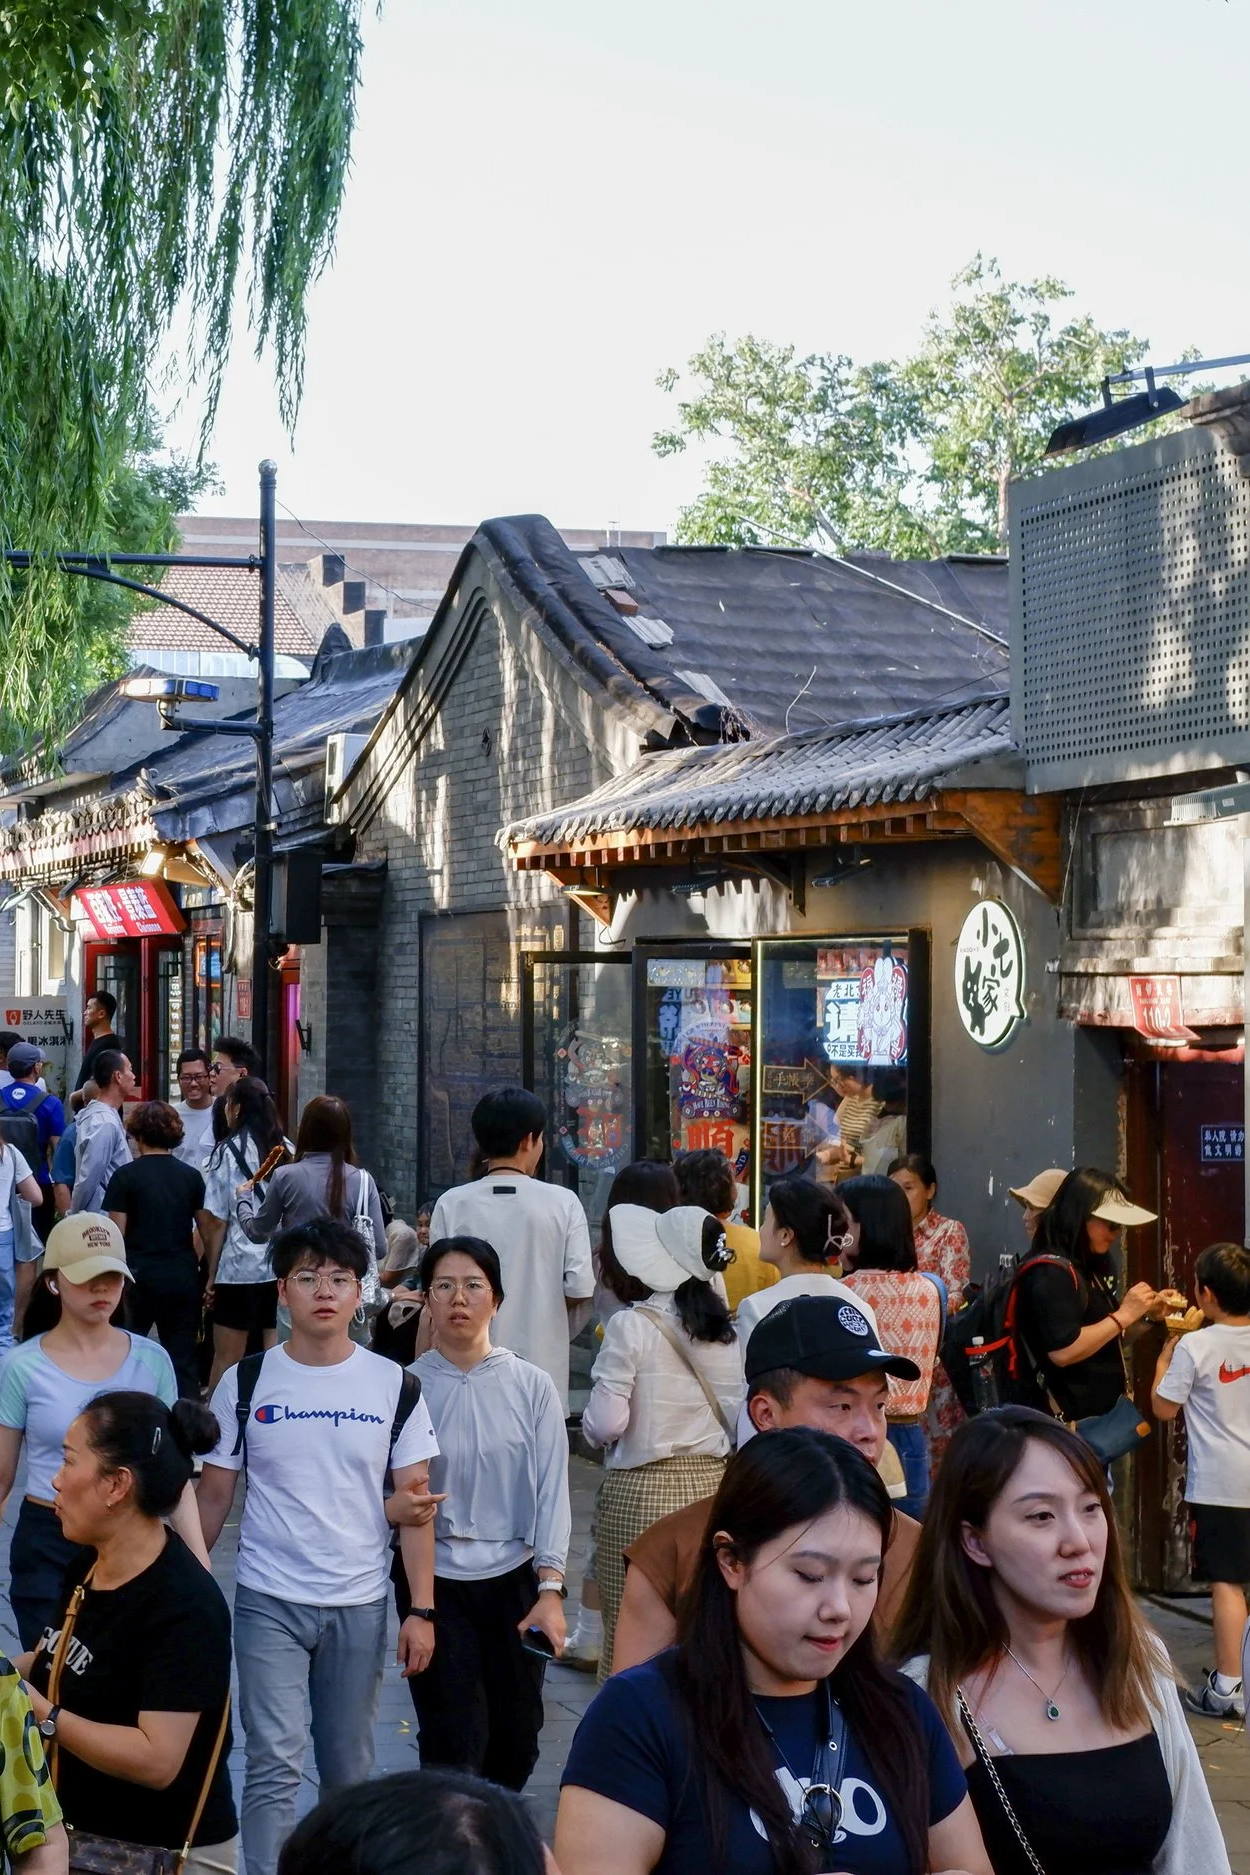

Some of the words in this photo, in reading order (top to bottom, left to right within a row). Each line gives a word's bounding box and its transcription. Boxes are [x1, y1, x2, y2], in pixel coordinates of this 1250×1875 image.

[833, 983, 862, 999] 老北
[22, 1009, 65, 1020] 野人先生
[254, 1404, 385, 1427] Champion
